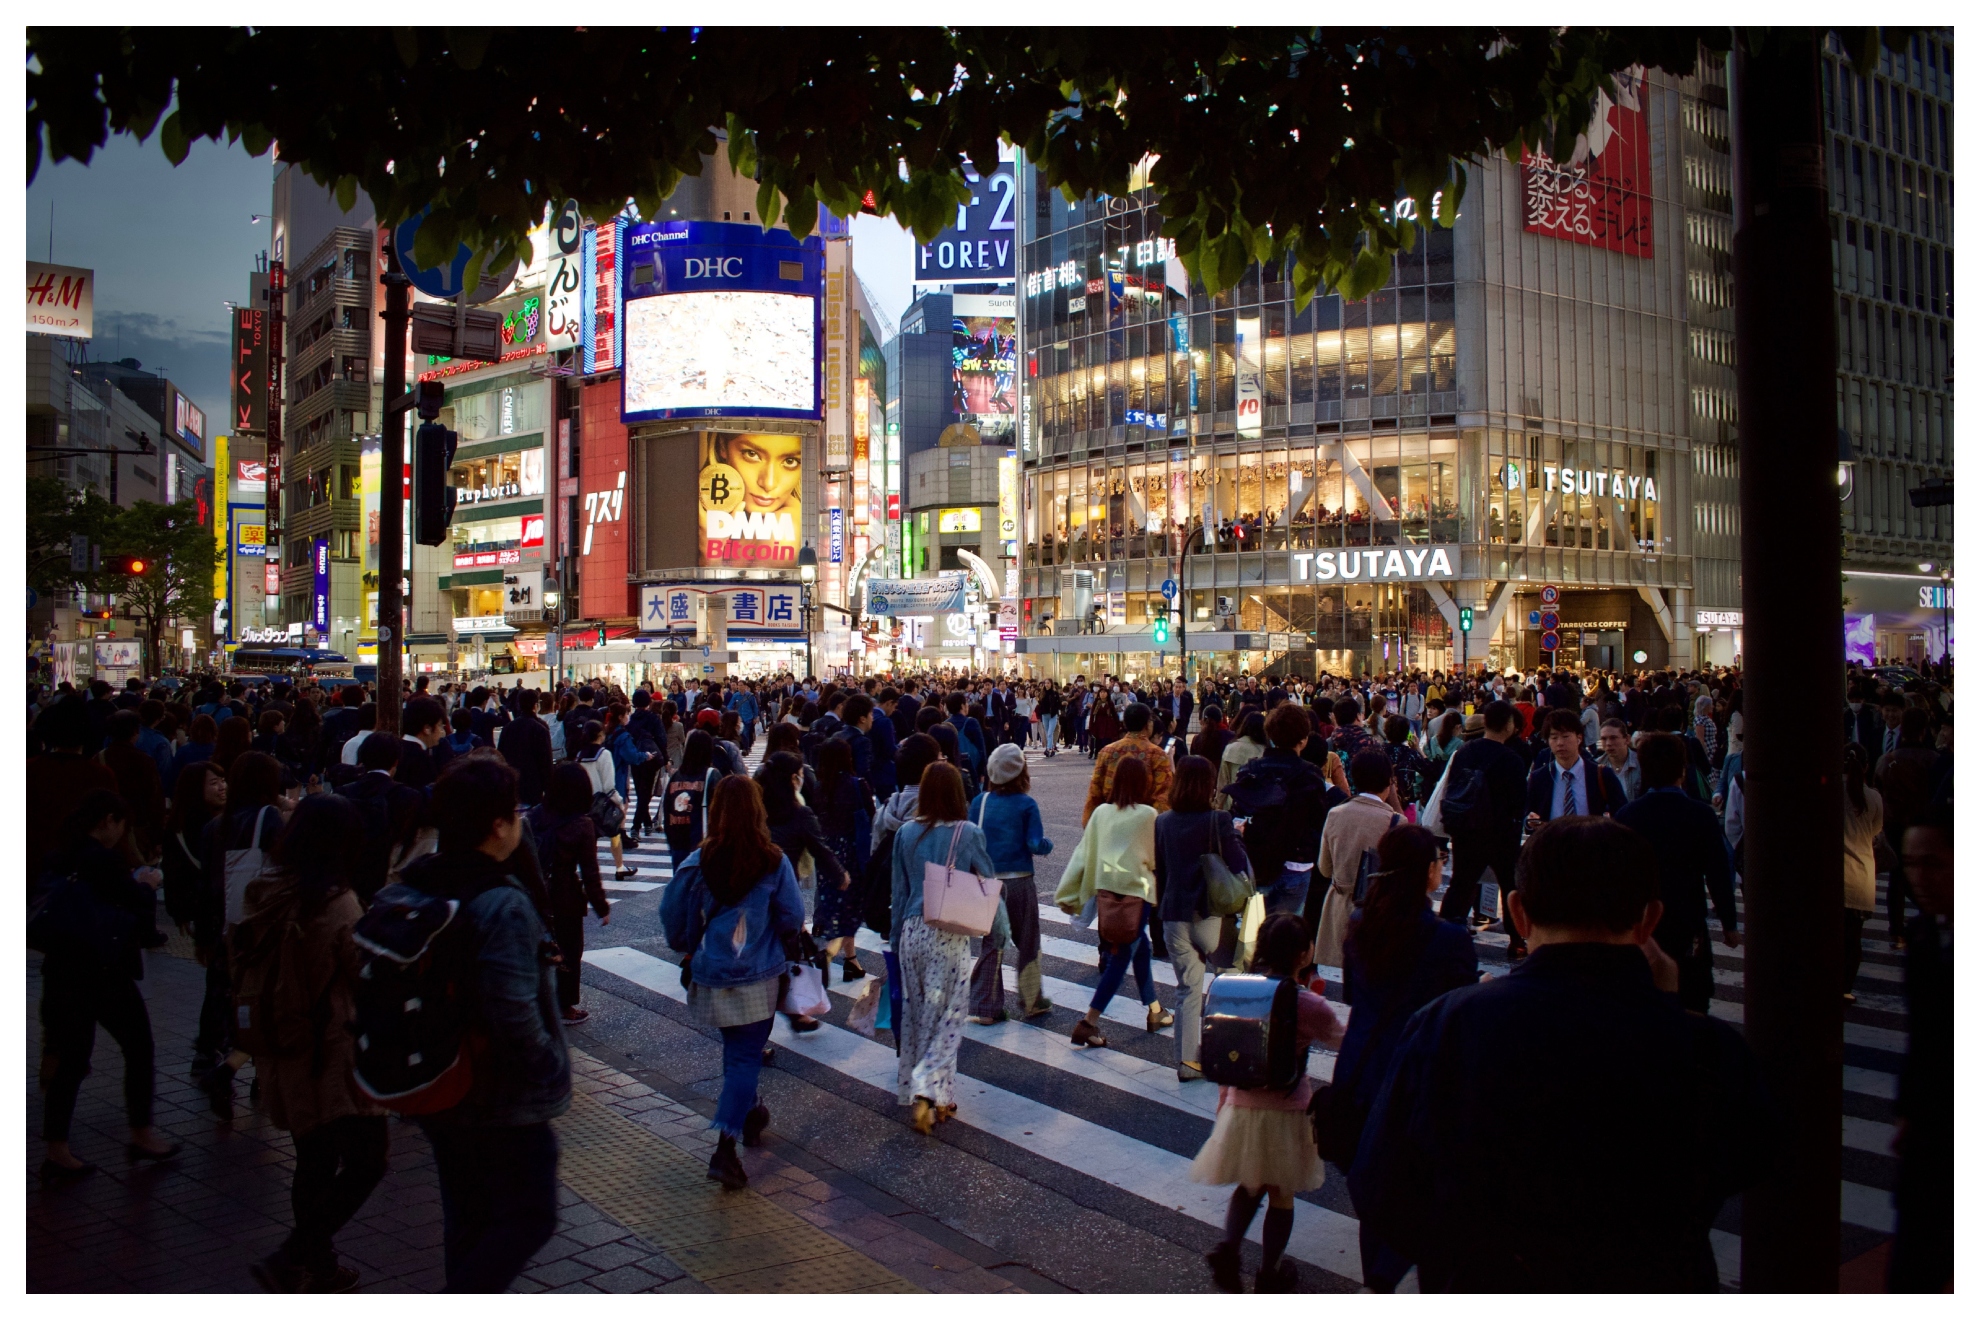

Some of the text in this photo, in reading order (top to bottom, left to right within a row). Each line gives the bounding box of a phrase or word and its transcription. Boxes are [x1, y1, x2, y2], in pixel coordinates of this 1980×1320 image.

[1527, 192, 1597, 240] 変える、
[1597, 208, 1649, 248] テレビ
[632, 229, 689, 246] DHC Channel
[684, 257, 743, 279] DHC
[921, 239, 1010, 270] FOREV
[549, 198, 580, 343] もんじゃ
[27, 272, 85, 311] H&M
[254, 310, 262, 347] TOKYO
[828, 265, 844, 410] Taisei neon
[705, 408, 722, 416] DHC
[456, 482, 518, 504] Euphoria
[1544, 466, 1658, 501] TSUTAYA
[245, 526, 264, 543] 薬
[706, 510, 796, 541] DMM
[1003, 521, 1014, 530] 4F
[319, 546, 327, 575] MIZUHO
[706, 540, 795, 561] Bitcoin
[1294, 548, 1453, 580] TSUTAYA
[647, 592, 793, 621] 大盛書店
[1697, 612, 1738, 623] TSUTAYA
[241, 625, 289, 643] グルメタウン
